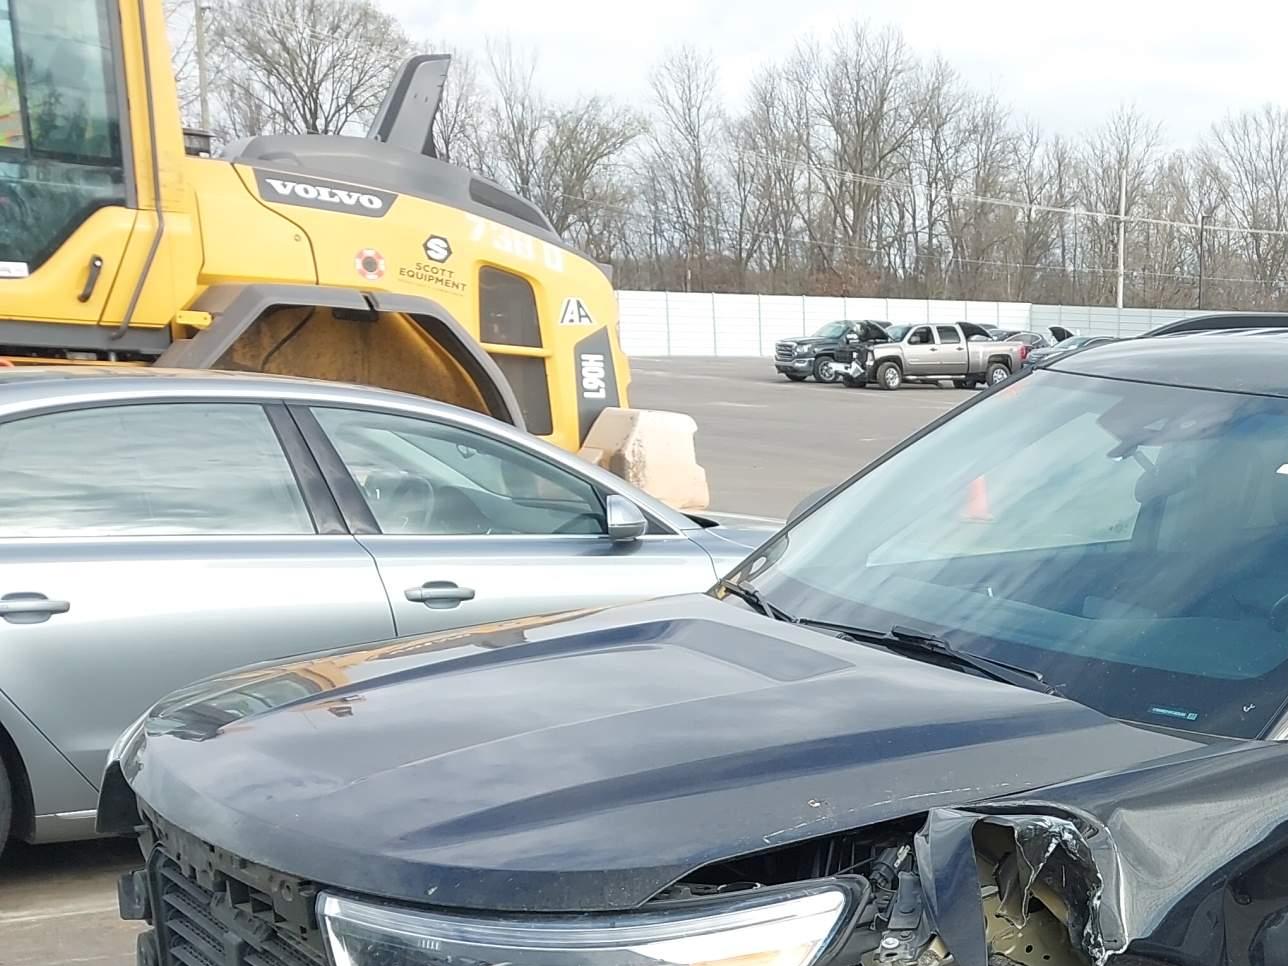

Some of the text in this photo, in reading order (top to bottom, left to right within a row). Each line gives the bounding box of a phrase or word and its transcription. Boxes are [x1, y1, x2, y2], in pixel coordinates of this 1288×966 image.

[264, 178, 383, 209] VOLVO
[399, 267, 467, 292] EQUIPMENT
[415, 262, 455, 278] SCOTT
[580, 353, 607, 399] L90H
